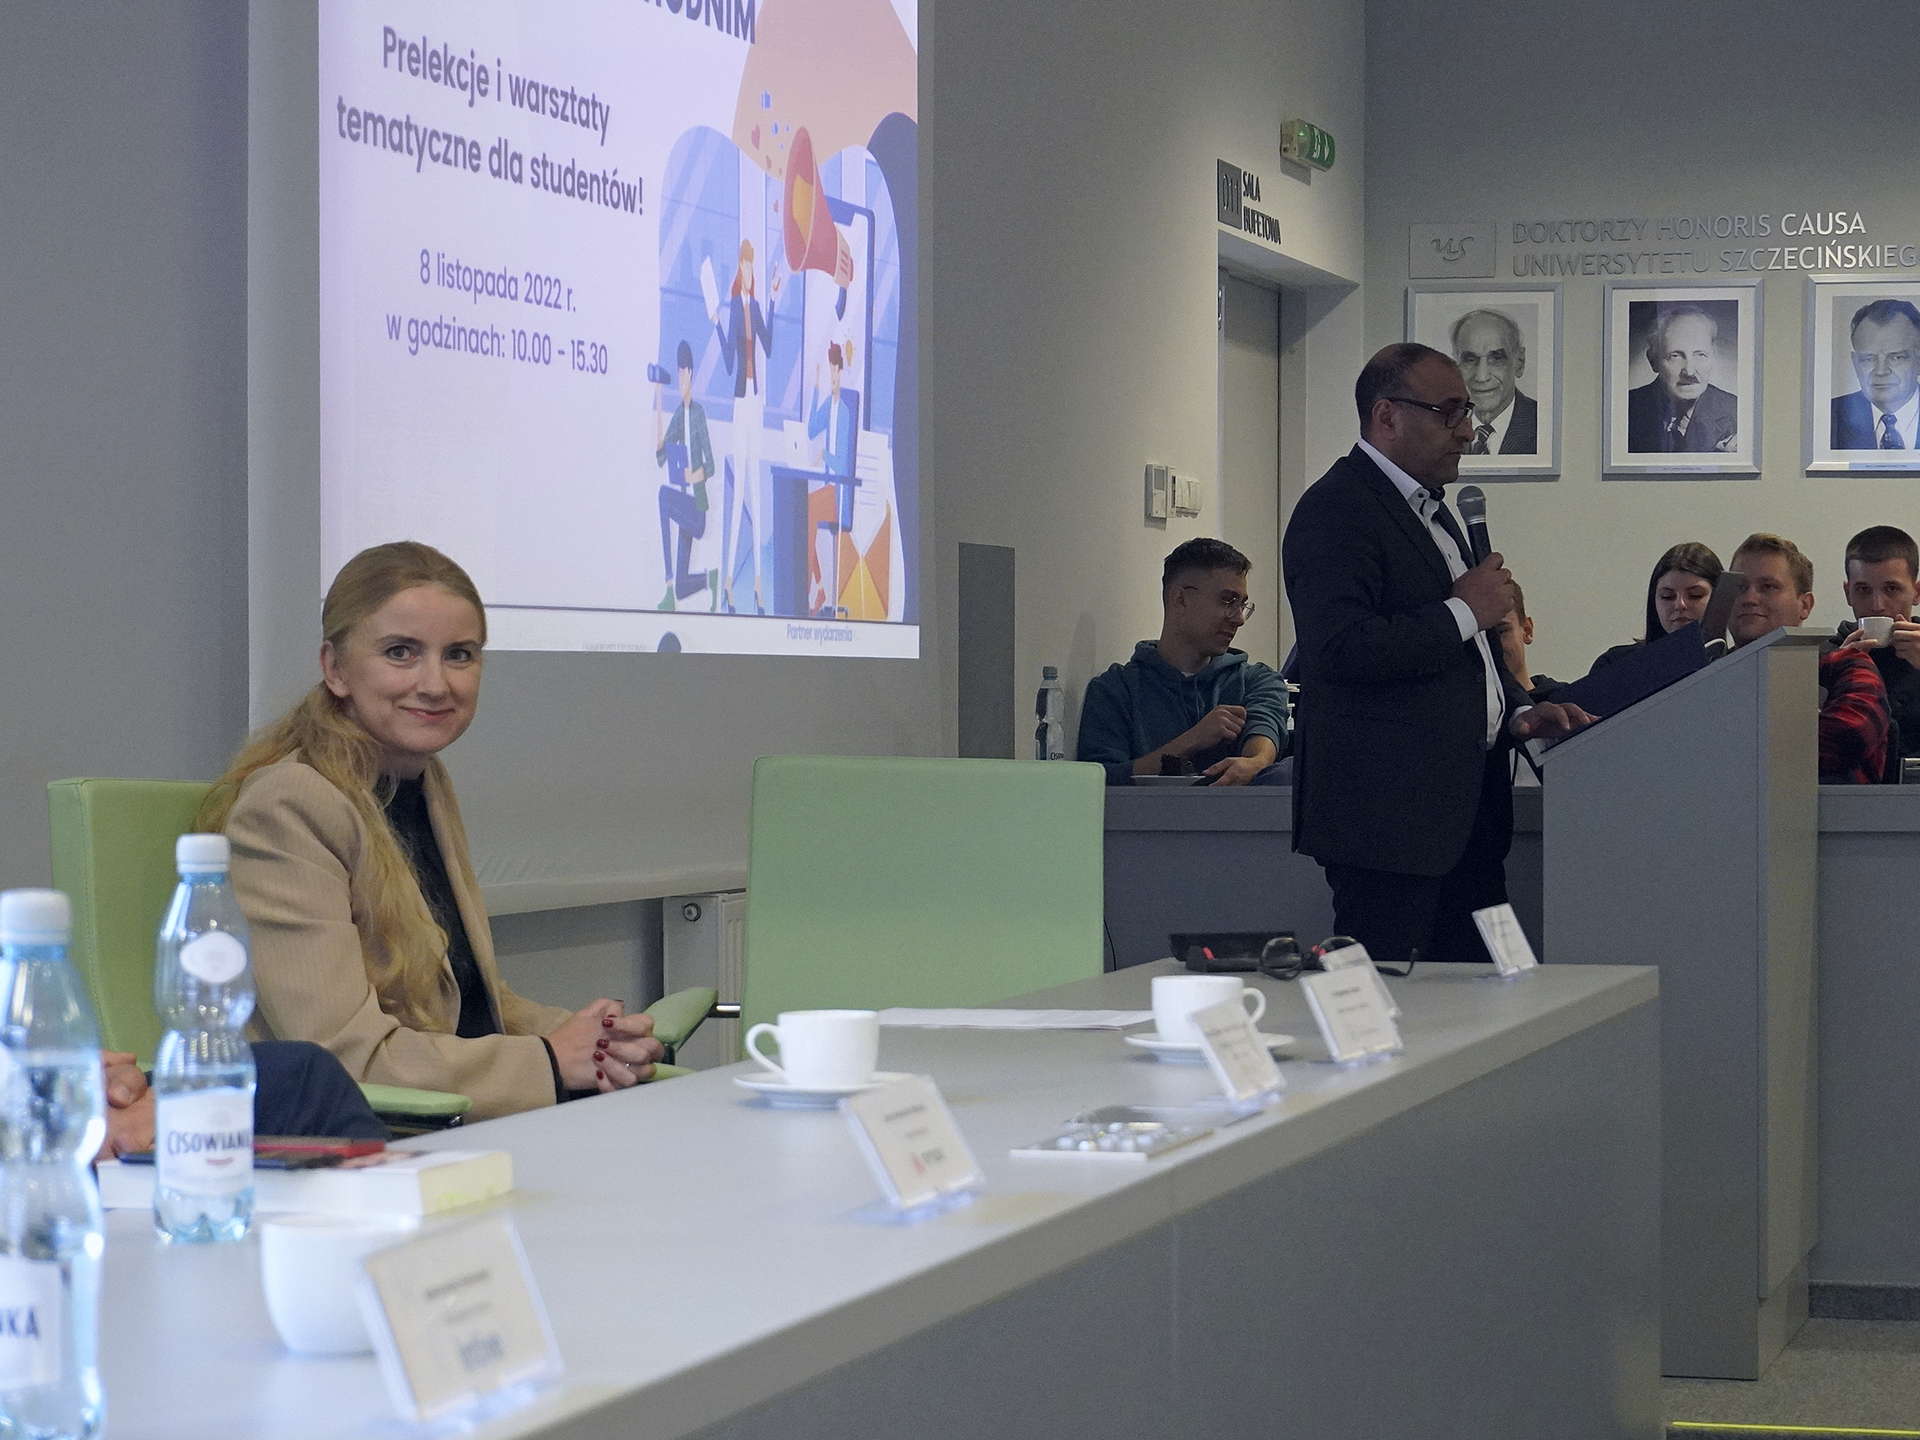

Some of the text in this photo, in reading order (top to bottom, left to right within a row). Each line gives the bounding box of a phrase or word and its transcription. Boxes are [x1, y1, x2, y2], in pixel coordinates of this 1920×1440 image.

[383, 25, 610, 147] Prelekcje i warsztaty
[336, 95, 643, 216] tematyczne dla studentów!
[1242, 170, 1261, 202] SALA
[1512, 211, 1867, 244] DOKTORZY HONORIS CAUSA
[419, 248, 577, 312] 8 listopada 2022 r.
[1512, 239, 1920, 278] UNIWERSYTETU SZCZECIŃSKIEG
[386, 313, 402, 341] w
[407, 314, 506, 356] godzinach:
[511, 328, 551, 366] 10.00
[570, 338, 608, 375] 15.30
[786, 623, 813, 641] Partner
